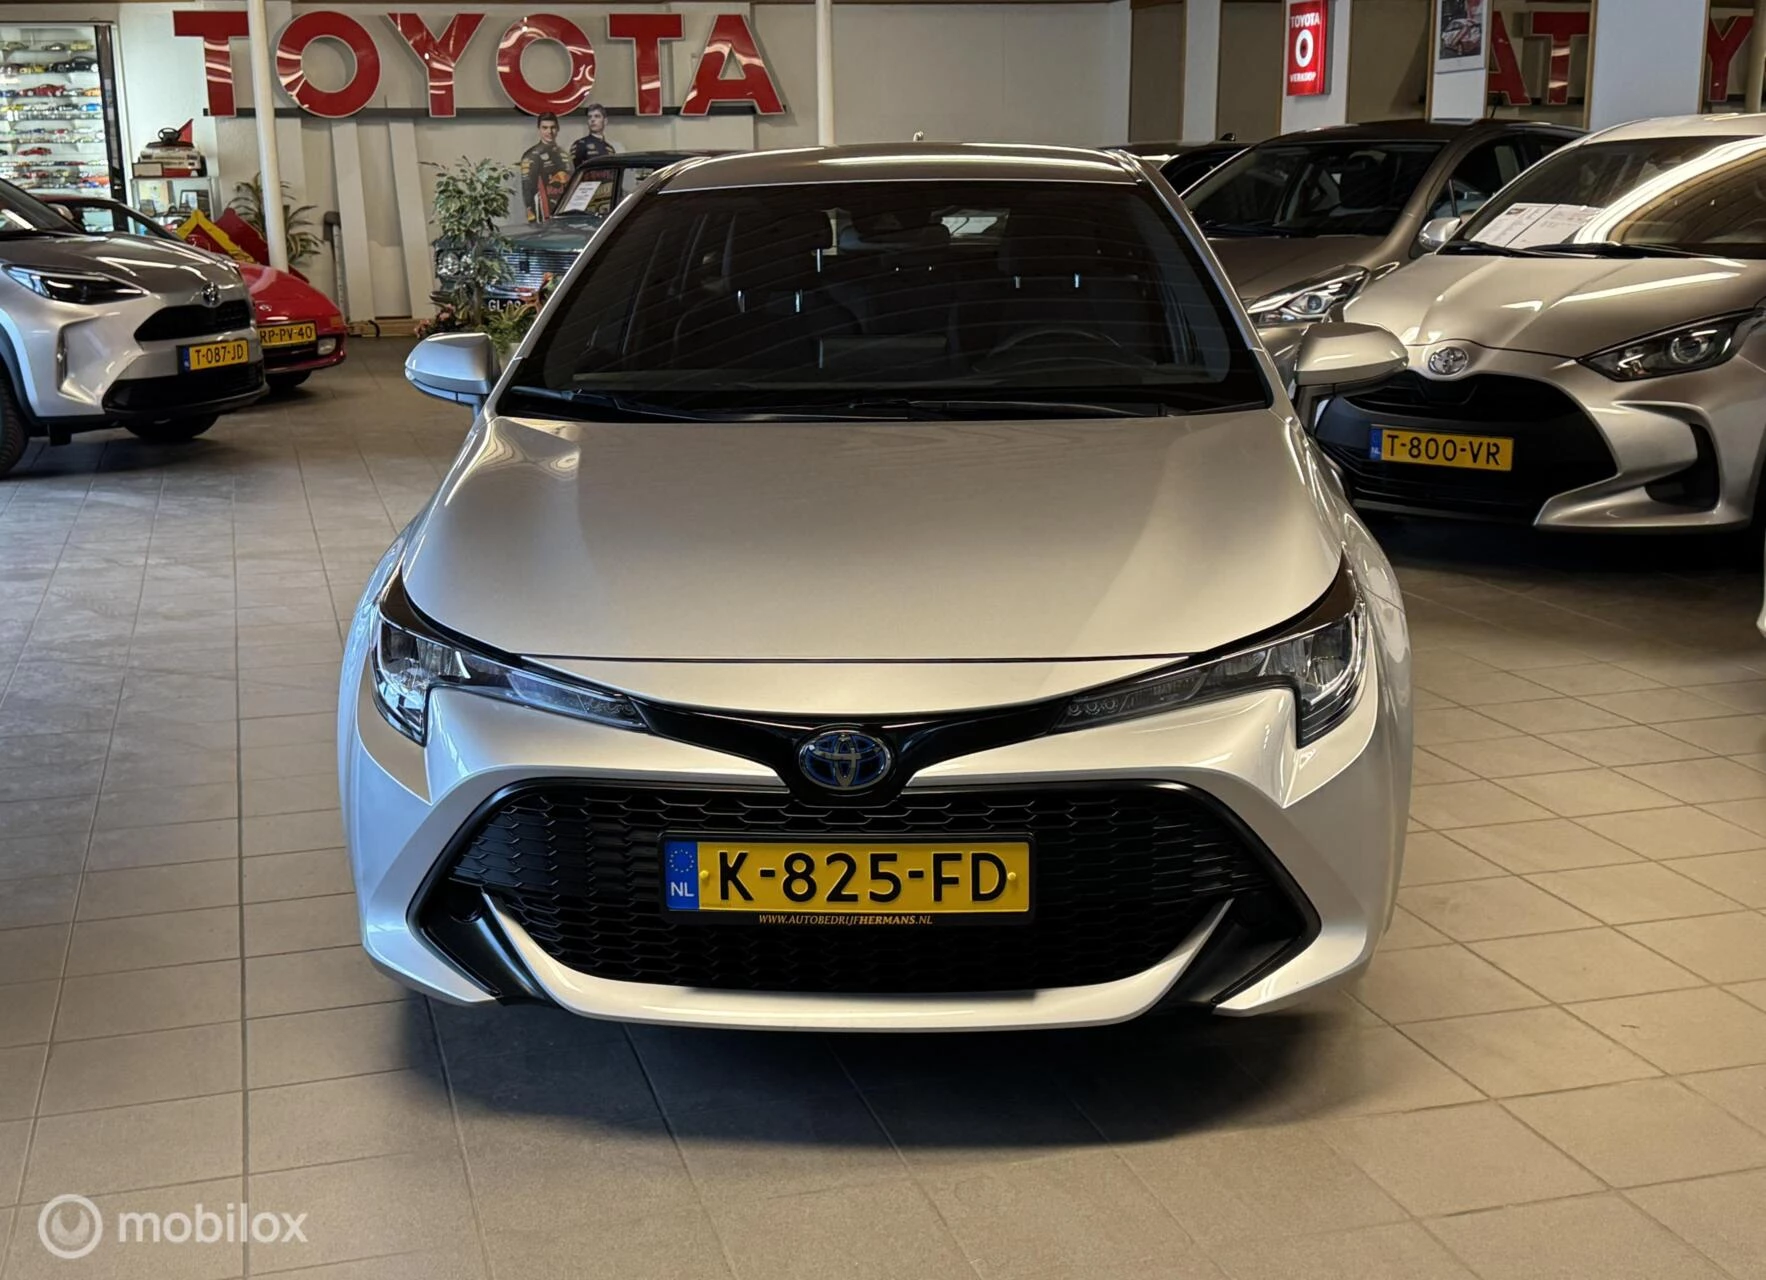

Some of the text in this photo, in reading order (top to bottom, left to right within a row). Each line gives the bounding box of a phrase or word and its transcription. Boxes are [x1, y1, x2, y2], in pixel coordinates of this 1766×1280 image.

[1290, 12, 1320, 28] TOYOTA
[172, 10, 785, 118] TOYOTA
[194, 343, 244, 366] T-087-JD
[1386, 435, 1501, 466] T-800-VR
[719, 851, 1008, 903] K-825-FD
[670, 882, 695, 898] NL
[758, 914, 933, 926] WWW.AUTOBEDRIJFHERMANS.NL
